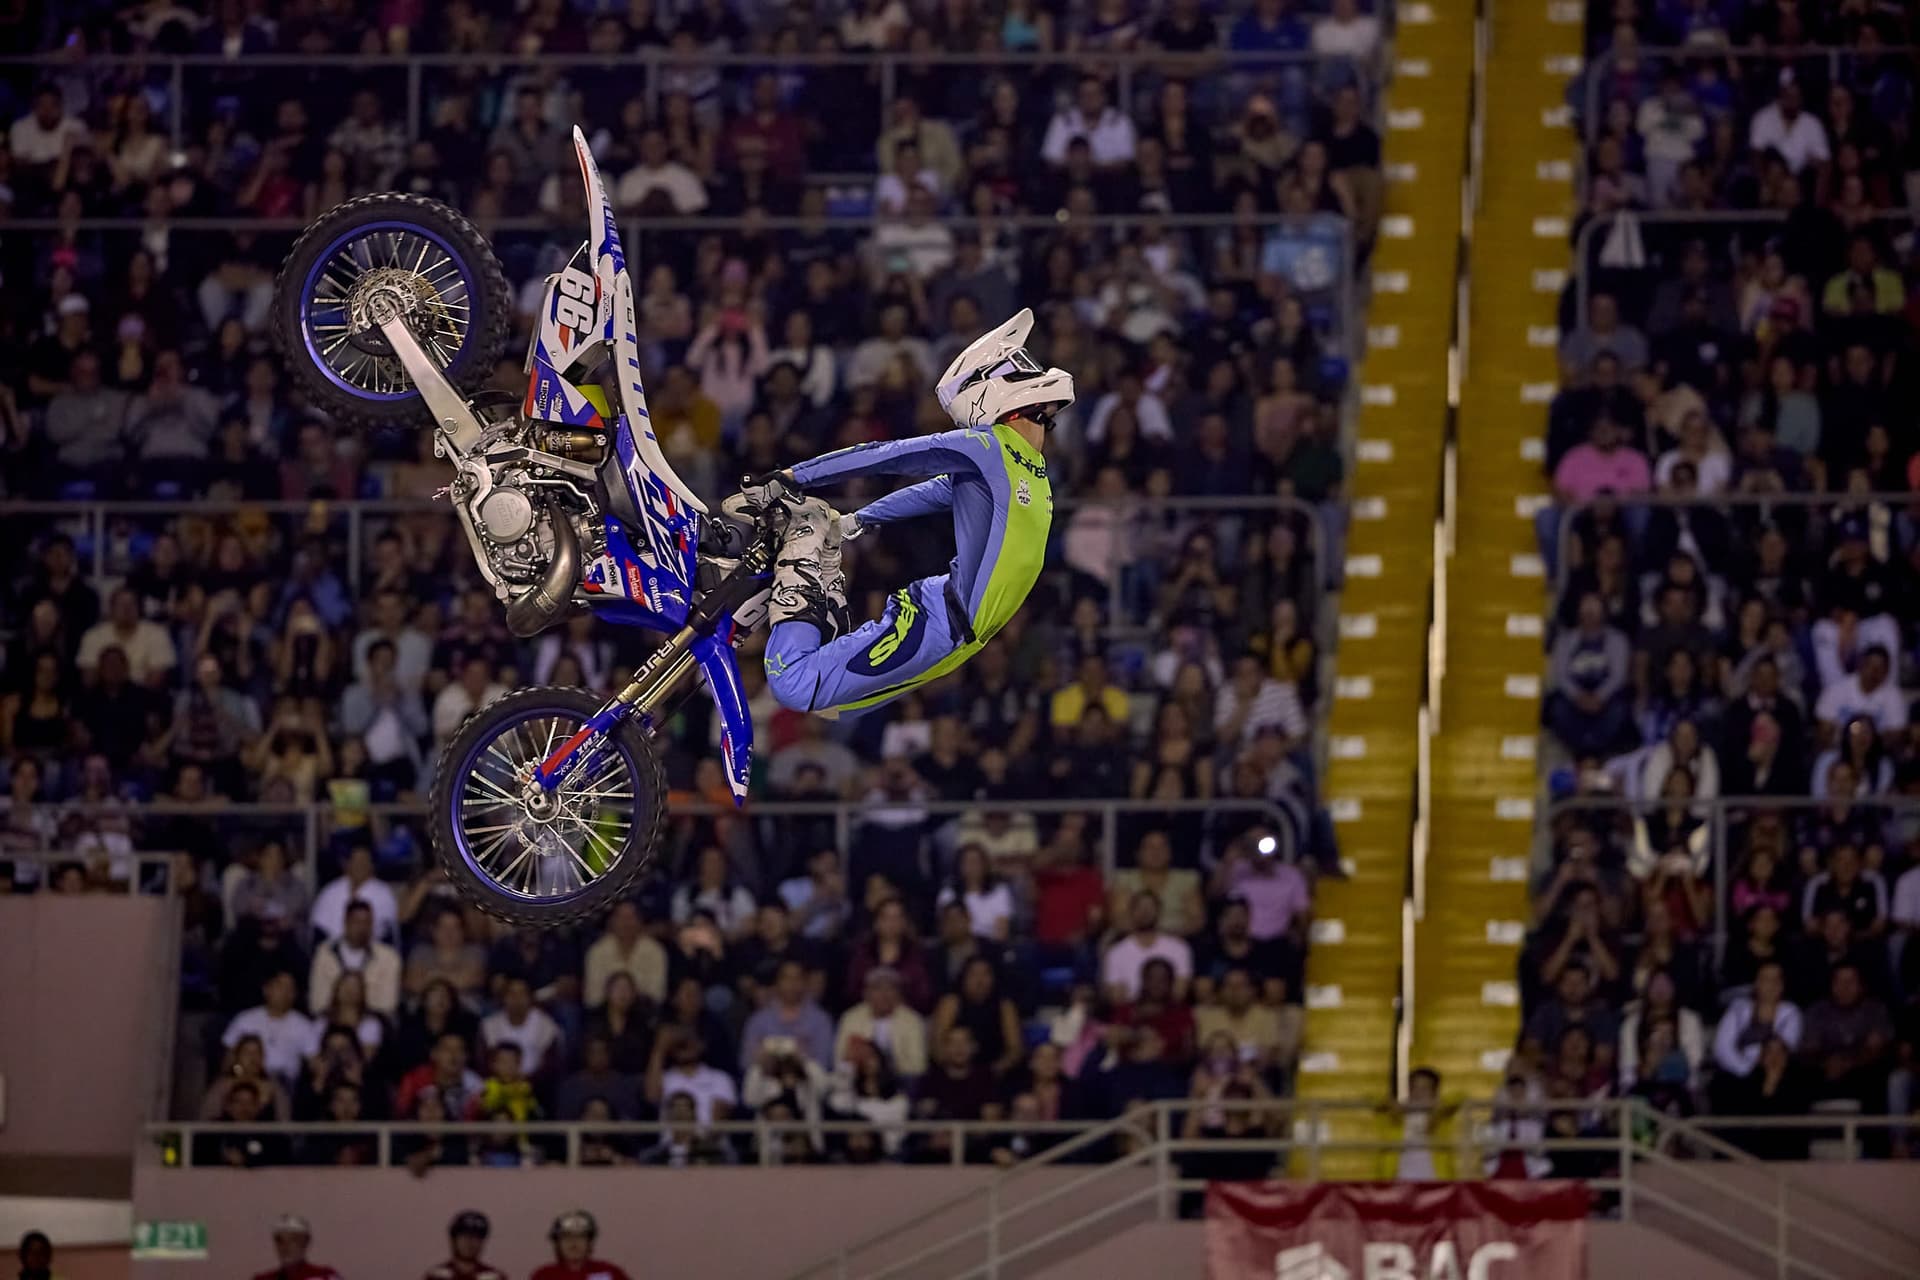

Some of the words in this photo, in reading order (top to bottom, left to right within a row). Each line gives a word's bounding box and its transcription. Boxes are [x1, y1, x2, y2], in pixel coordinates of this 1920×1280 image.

[650, 584, 664, 614] YAMAHA
[633, 639, 674, 683] RJC
[1363, 1241, 1519, 1280] BAC
